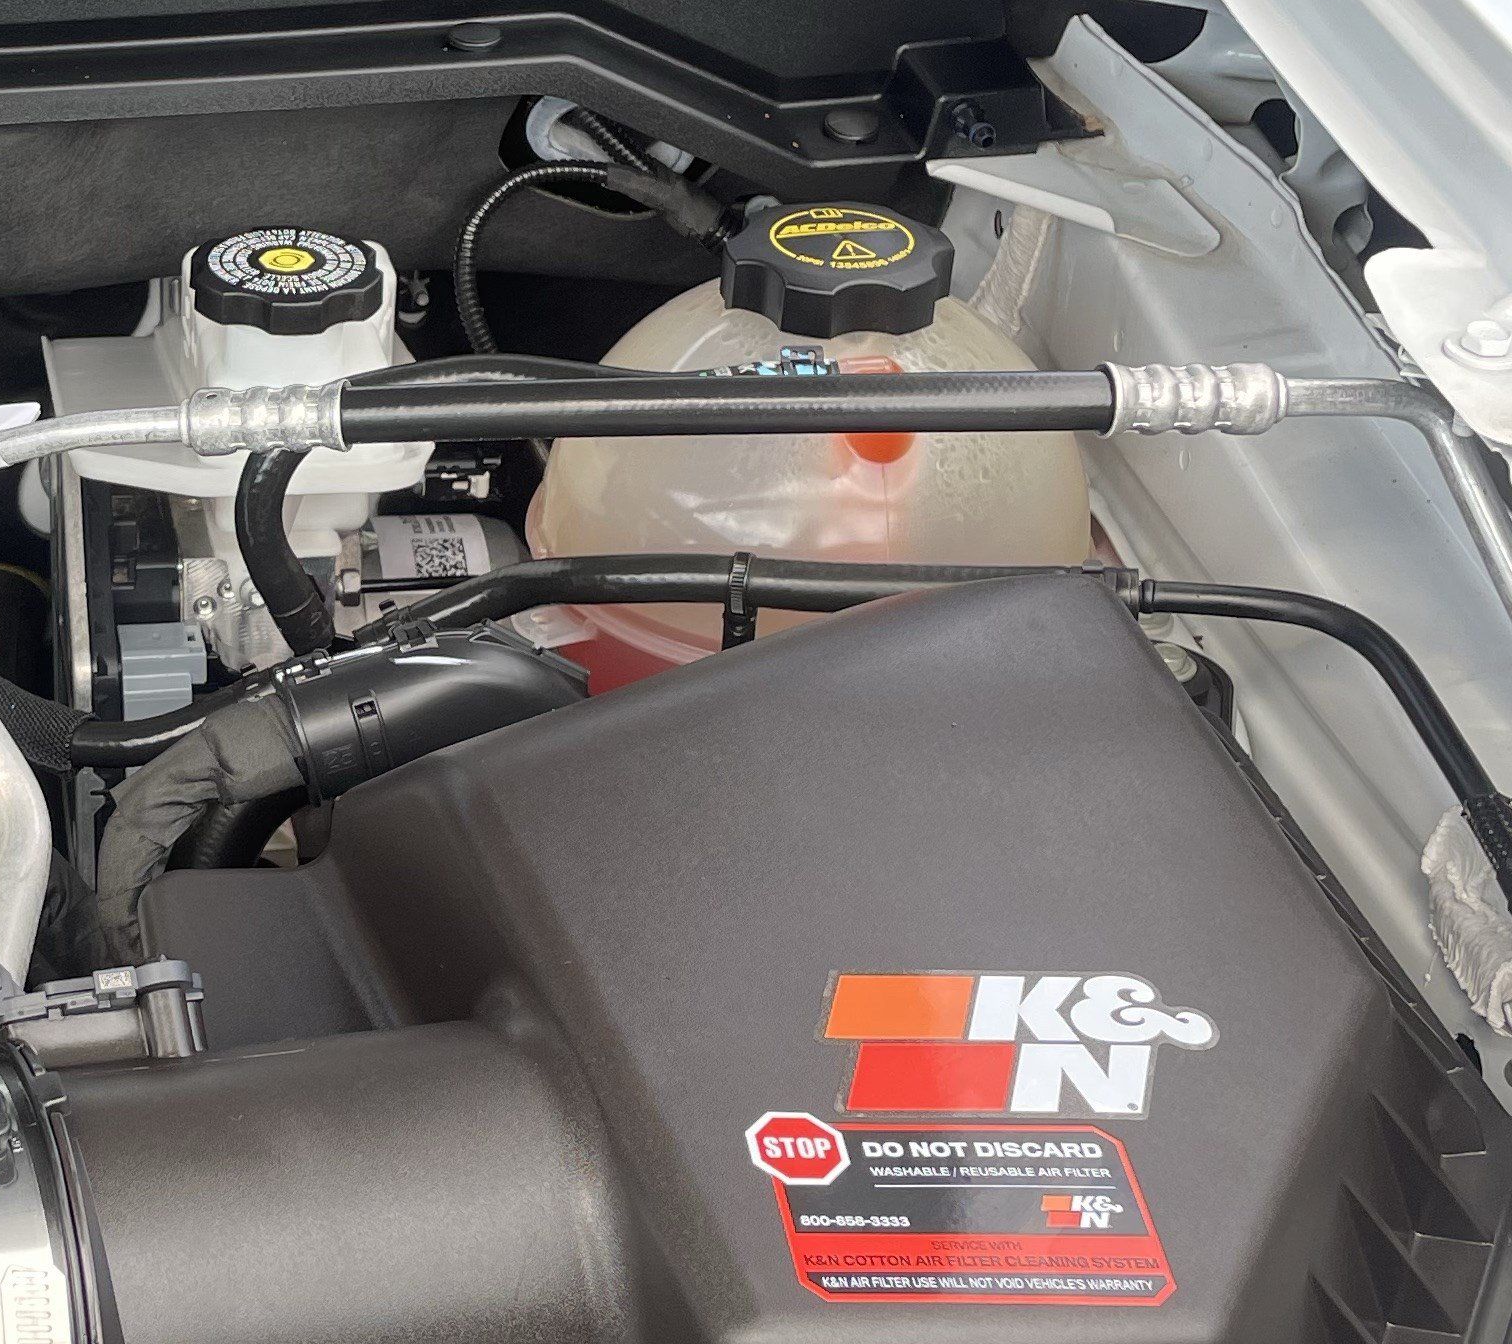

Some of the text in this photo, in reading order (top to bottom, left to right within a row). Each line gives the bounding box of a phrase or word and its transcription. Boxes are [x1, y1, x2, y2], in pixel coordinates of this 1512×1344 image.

[779, 221, 896, 235] ACDelco
[761, 1136, 832, 1160] STOP
[861, 1141, 1104, 1158] DO NOT DISCARD
[869, 1166, 951, 1177] WASHABLE
[960, 1166, 1035, 1178] REUSABLE
[1037, 1167, 1063, 1178] AIR
[1064, 1167, 1112, 1179] FILTER
[930, 1240, 1023, 1252] SERVICE WITH
[803, 1254, 1160, 1269] K&N COTTON AIR FILTER CLEANING SYSTEM
[821, 1276, 1154, 1291] K&N AIR FILTER USE WILL NOT VOID VEHICLE'S WARRANTY
